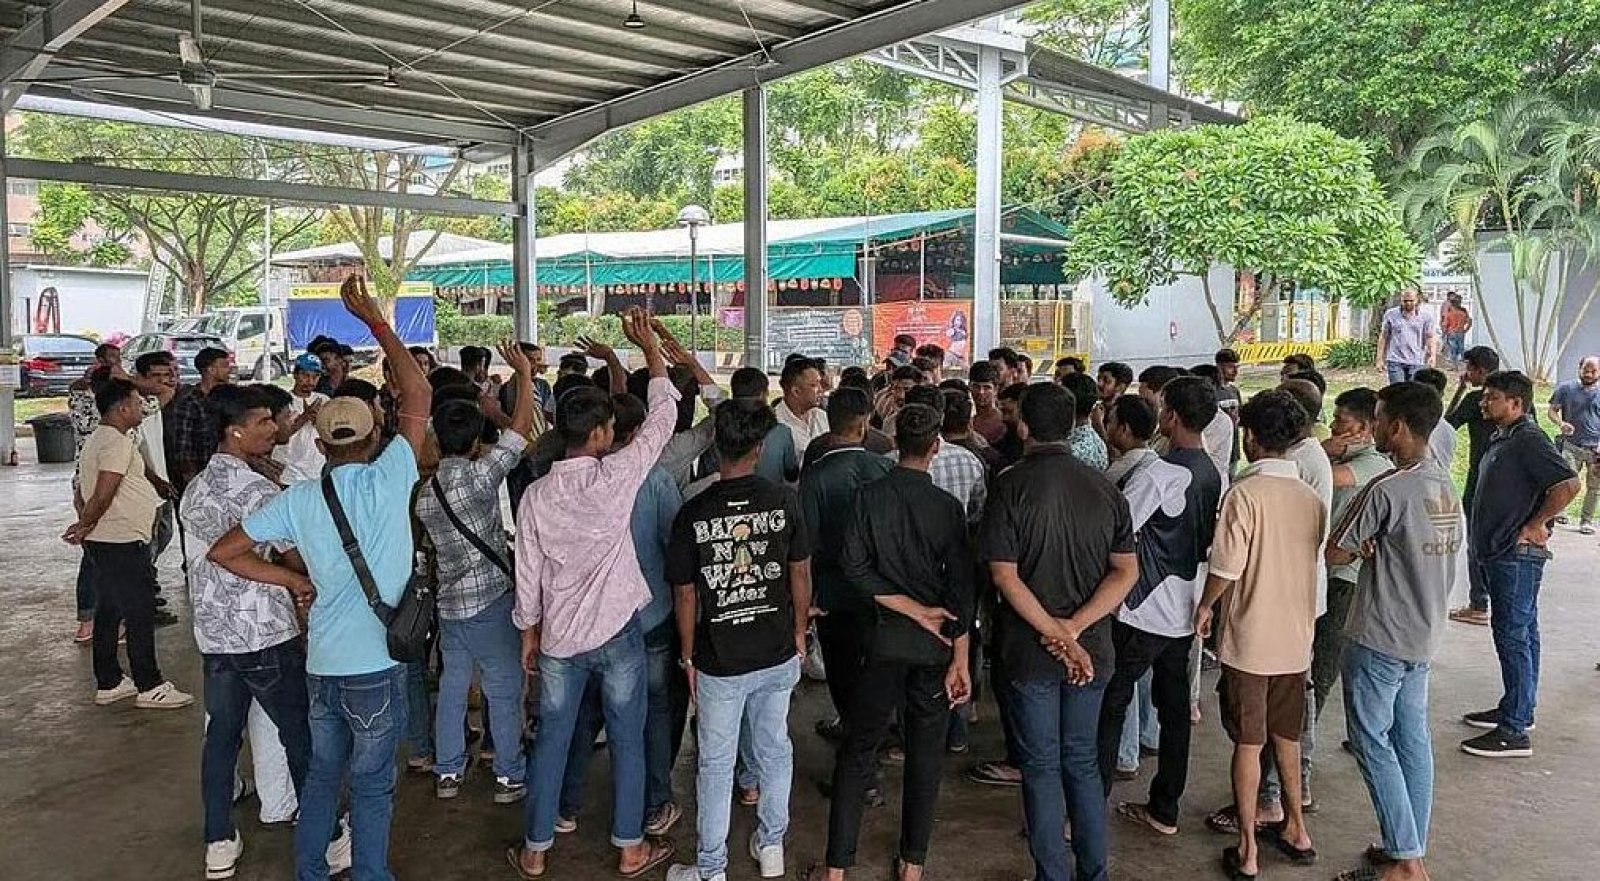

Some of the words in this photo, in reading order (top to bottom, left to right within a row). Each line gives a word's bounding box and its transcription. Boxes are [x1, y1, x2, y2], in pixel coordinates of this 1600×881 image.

[693, 509, 786, 543] BANG
[712, 541, 769, 562] Nw
[700, 561, 782, 589] Wne
[717, 586, 767, 607] Later
